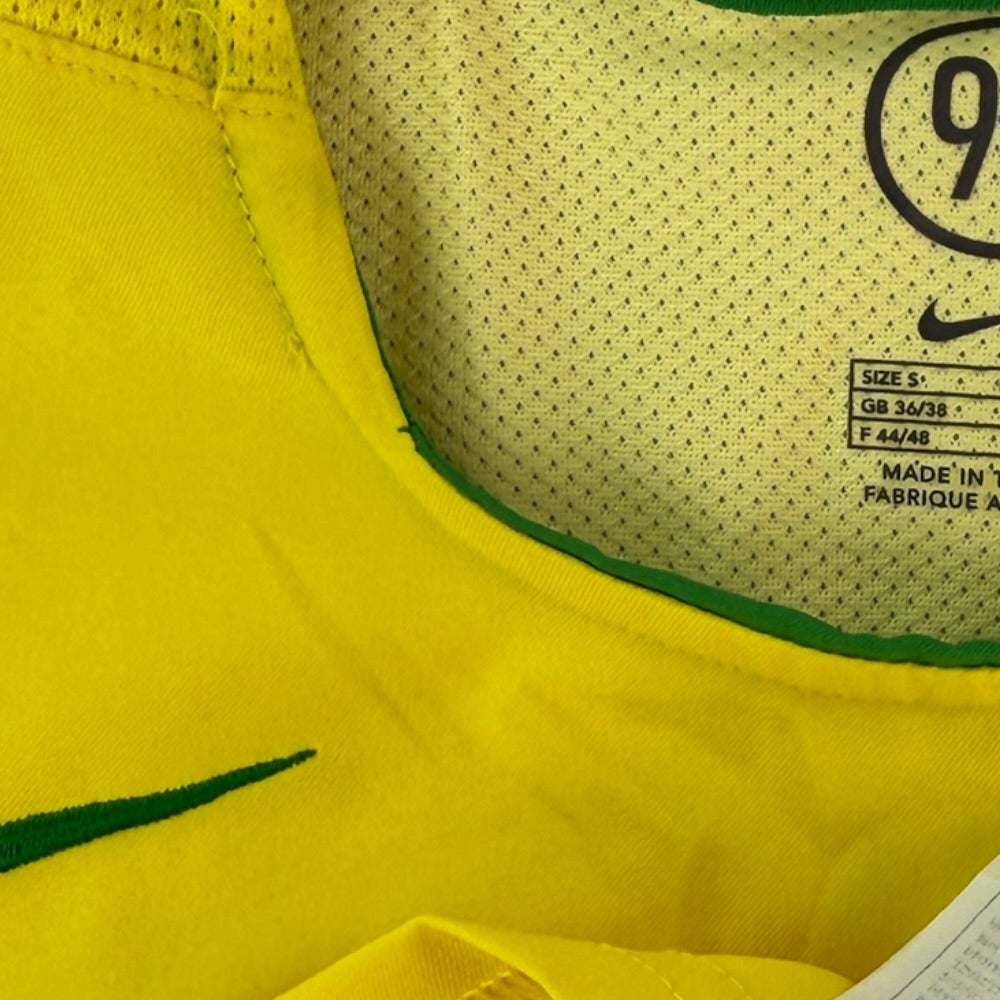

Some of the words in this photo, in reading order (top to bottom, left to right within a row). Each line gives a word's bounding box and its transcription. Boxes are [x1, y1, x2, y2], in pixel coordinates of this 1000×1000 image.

[862, 369, 902, 387] SIZE
[907, 371, 920, 387] S
[861, 398, 889, 415] GB
[894, 400, 948, 418] 36/38
[859, 426, 872, 442] F
[875, 427, 931, 446] 44/48
[882, 462, 951, 485] MADE
[959, 467, 984, 487] IN
[863, 486, 978, 511] FABRIQUE
